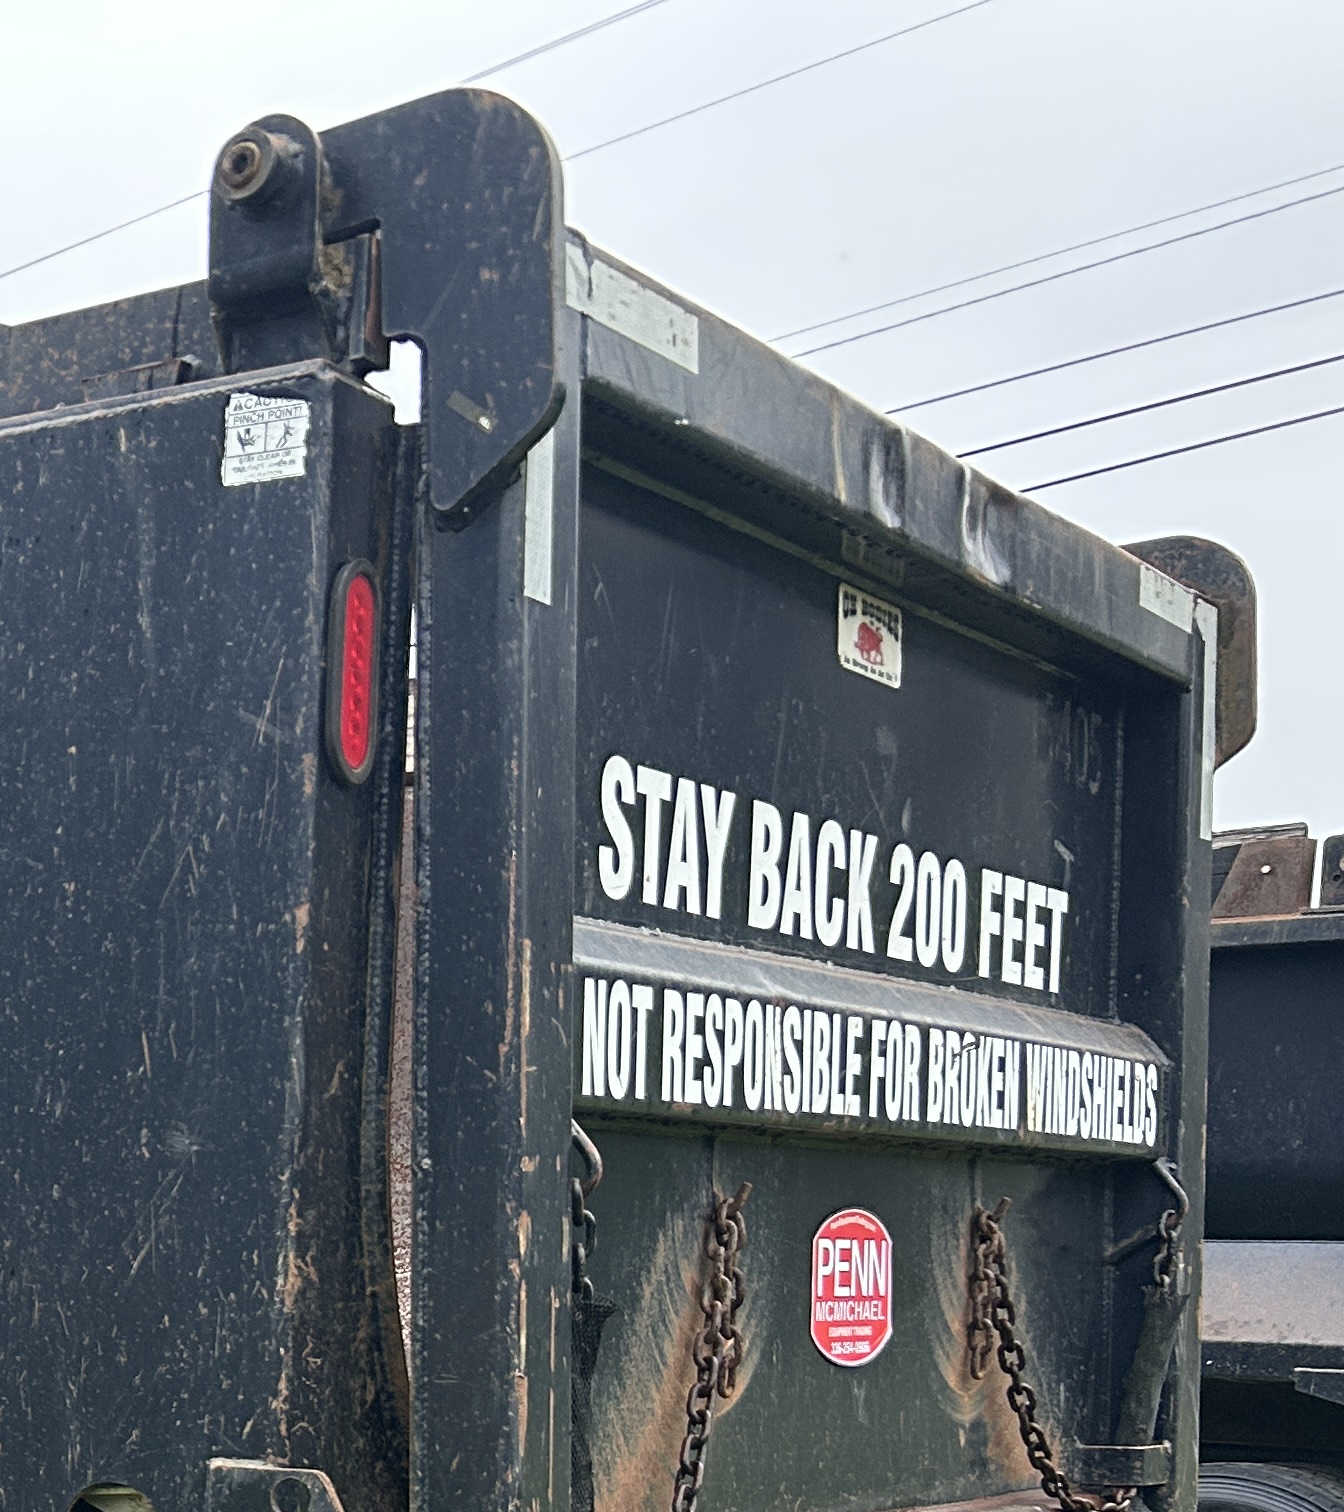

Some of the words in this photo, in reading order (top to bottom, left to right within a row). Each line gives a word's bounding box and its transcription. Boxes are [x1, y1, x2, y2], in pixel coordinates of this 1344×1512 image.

[233, 411, 264, 425] PINCH
[599, 754, 736, 920] STAY
[748, 799, 879, 953] BACK
[887, 843, 967, 973] 200
[979, 867, 1069, 994] FEET
[582, 977, 654, 1100] NOT
[661, 988, 863, 1118] RESPONSIBLE
[869, 1020, 922, 1122] FOR
[928, 1023, 1021, 1131] BROKEN
[1026, 1042, 1160, 1148] WINDSHIELDS
[817, 1238, 887, 1297] PENN
[815, 1300, 886, 1322] MCMICHAEL
